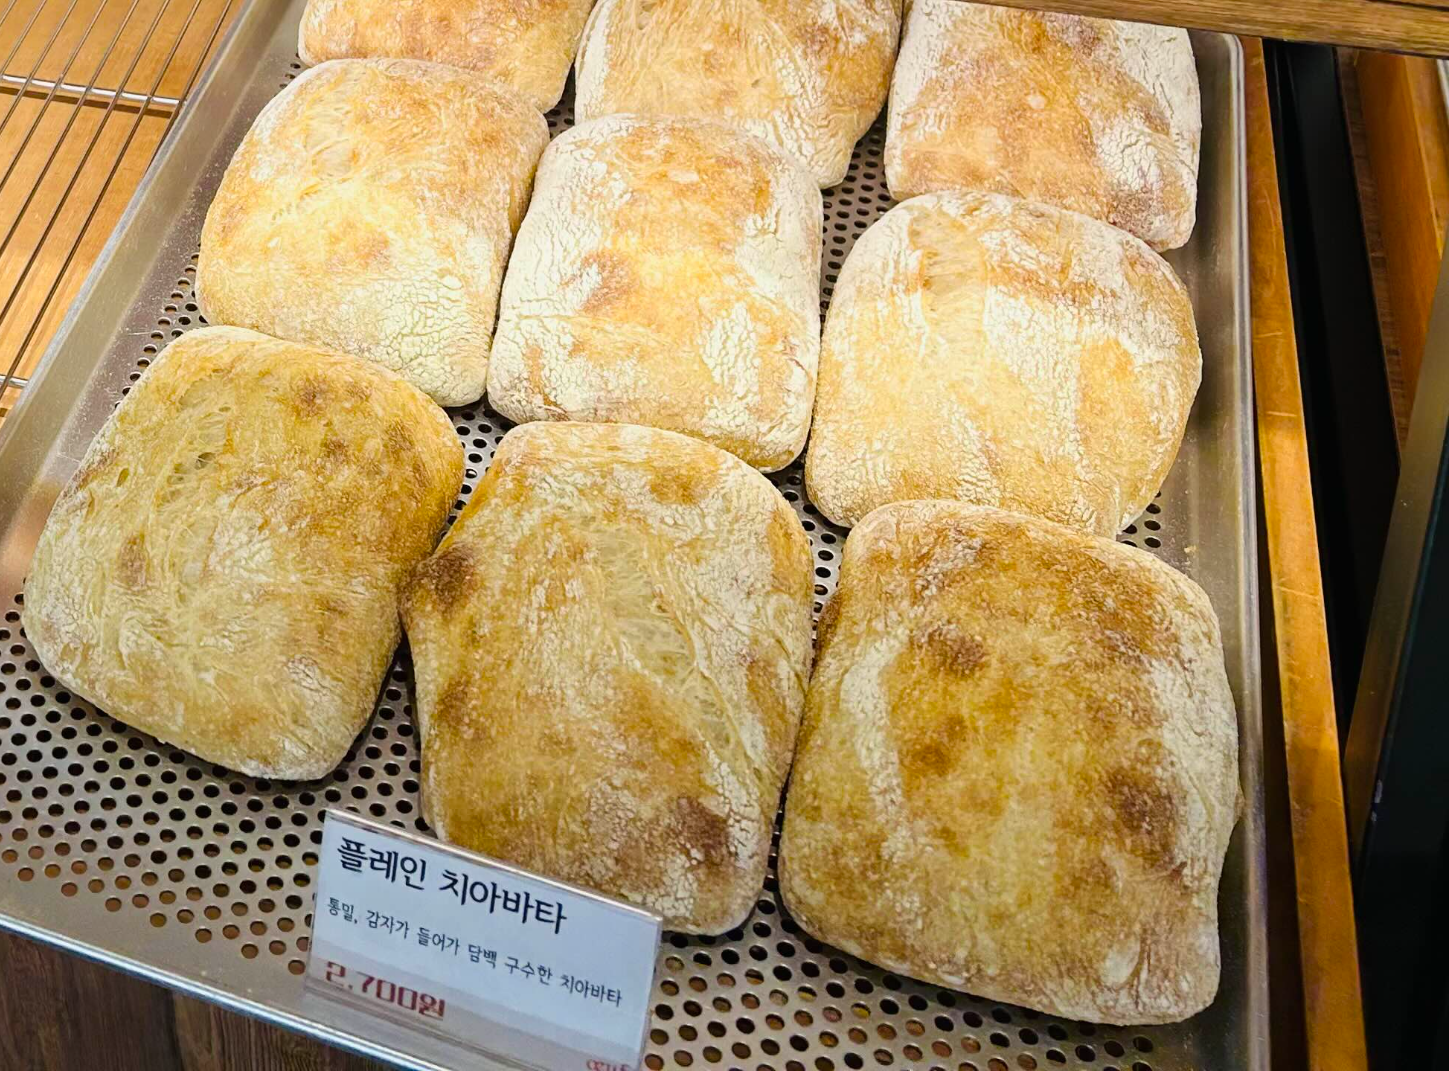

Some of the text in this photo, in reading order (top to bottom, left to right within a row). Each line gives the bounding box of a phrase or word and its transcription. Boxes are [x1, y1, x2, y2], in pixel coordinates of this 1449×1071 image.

[337, 836, 568, 935] 플레인 치아바타
[327, 896, 622, 1008] 통밀, 감자가 들어가 담백 구수한 치아바타
